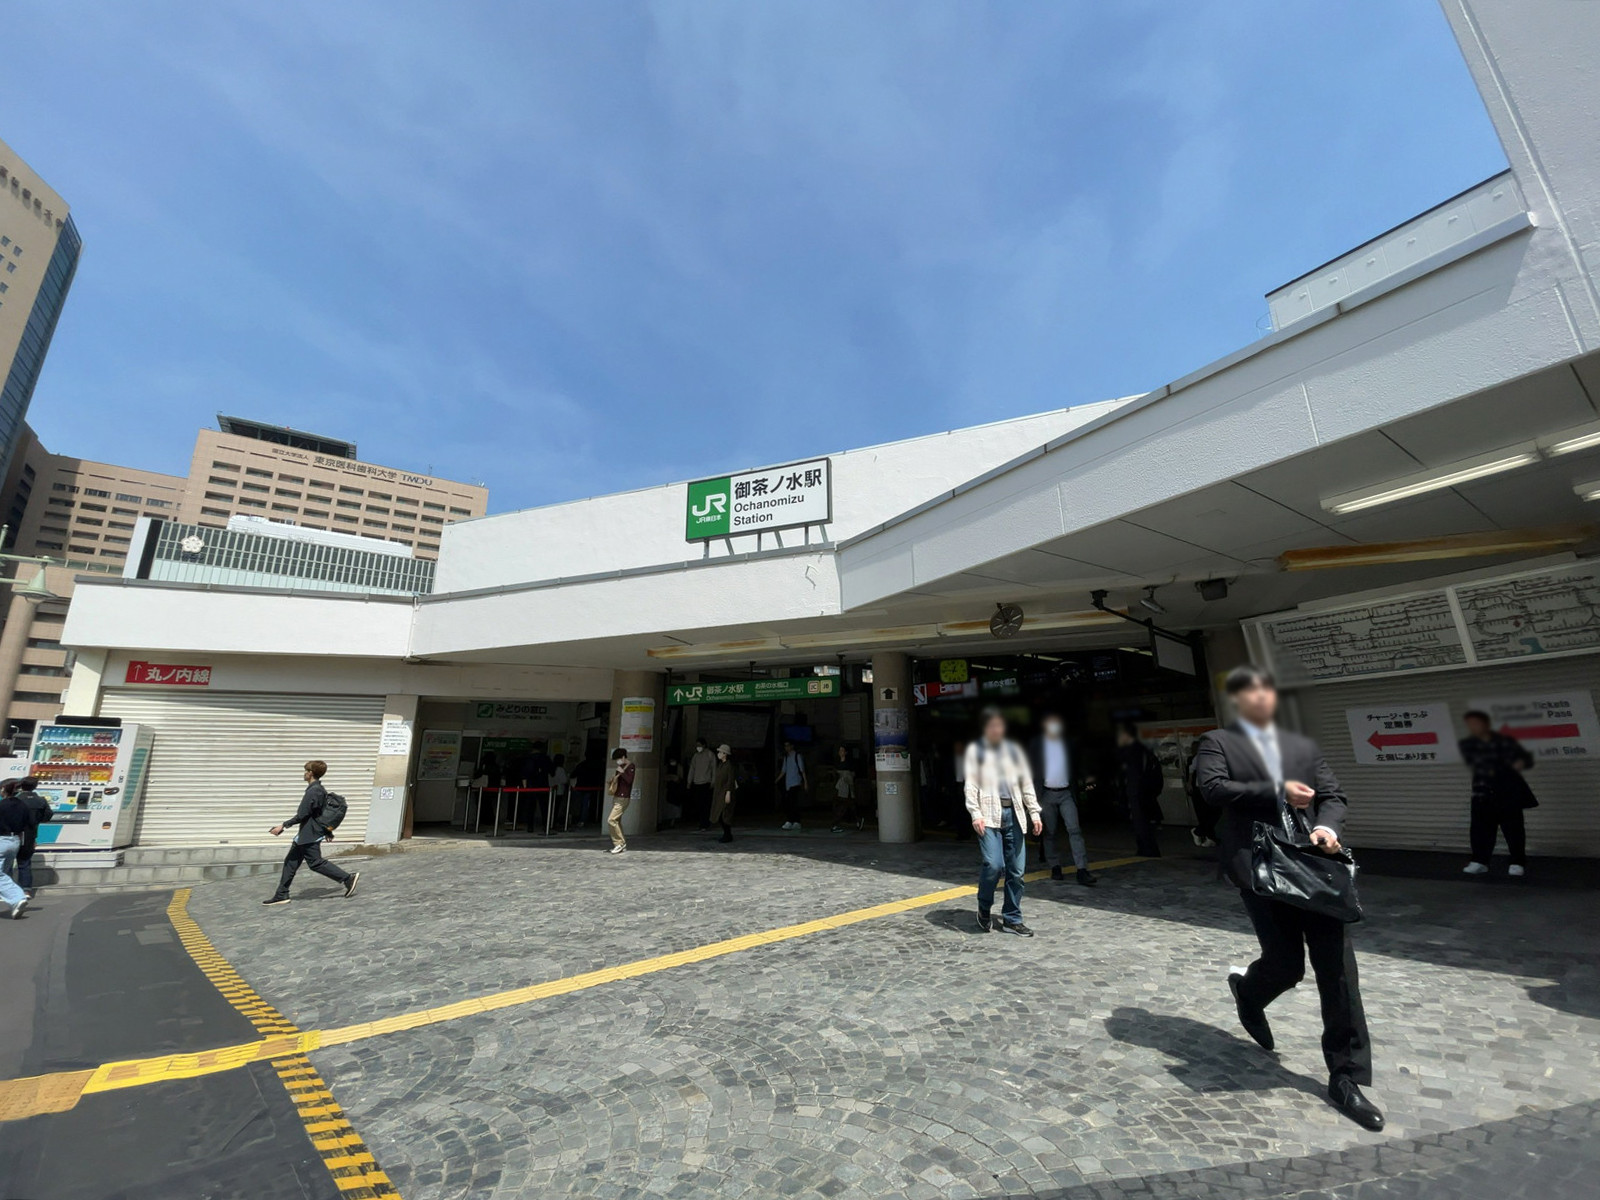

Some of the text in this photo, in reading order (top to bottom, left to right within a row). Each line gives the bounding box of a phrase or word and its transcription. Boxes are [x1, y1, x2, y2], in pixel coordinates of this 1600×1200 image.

[314, 456, 433, 486] 東京医科歯科大学 TMDU
[734, 468, 822, 500] 御茶ノ水駅
[692, 493, 727, 517] JR
[734, 494, 805, 513] Ochanomizu
[695, 514, 722, 524] JR東日本
[734, 513, 773, 526] Station
[145, 667, 210, 683] 丸ノ内線
[685, 686, 703, 698] JR
[706, 684, 745, 695] 御茶ノ水駅
[496, 704, 547, 714] みどりの窓口
[1547, 710, 1573, 718] Pass
[1563, 746, 1587, 755] Side
[1376, 752, 1436, 762] 左側にあります
